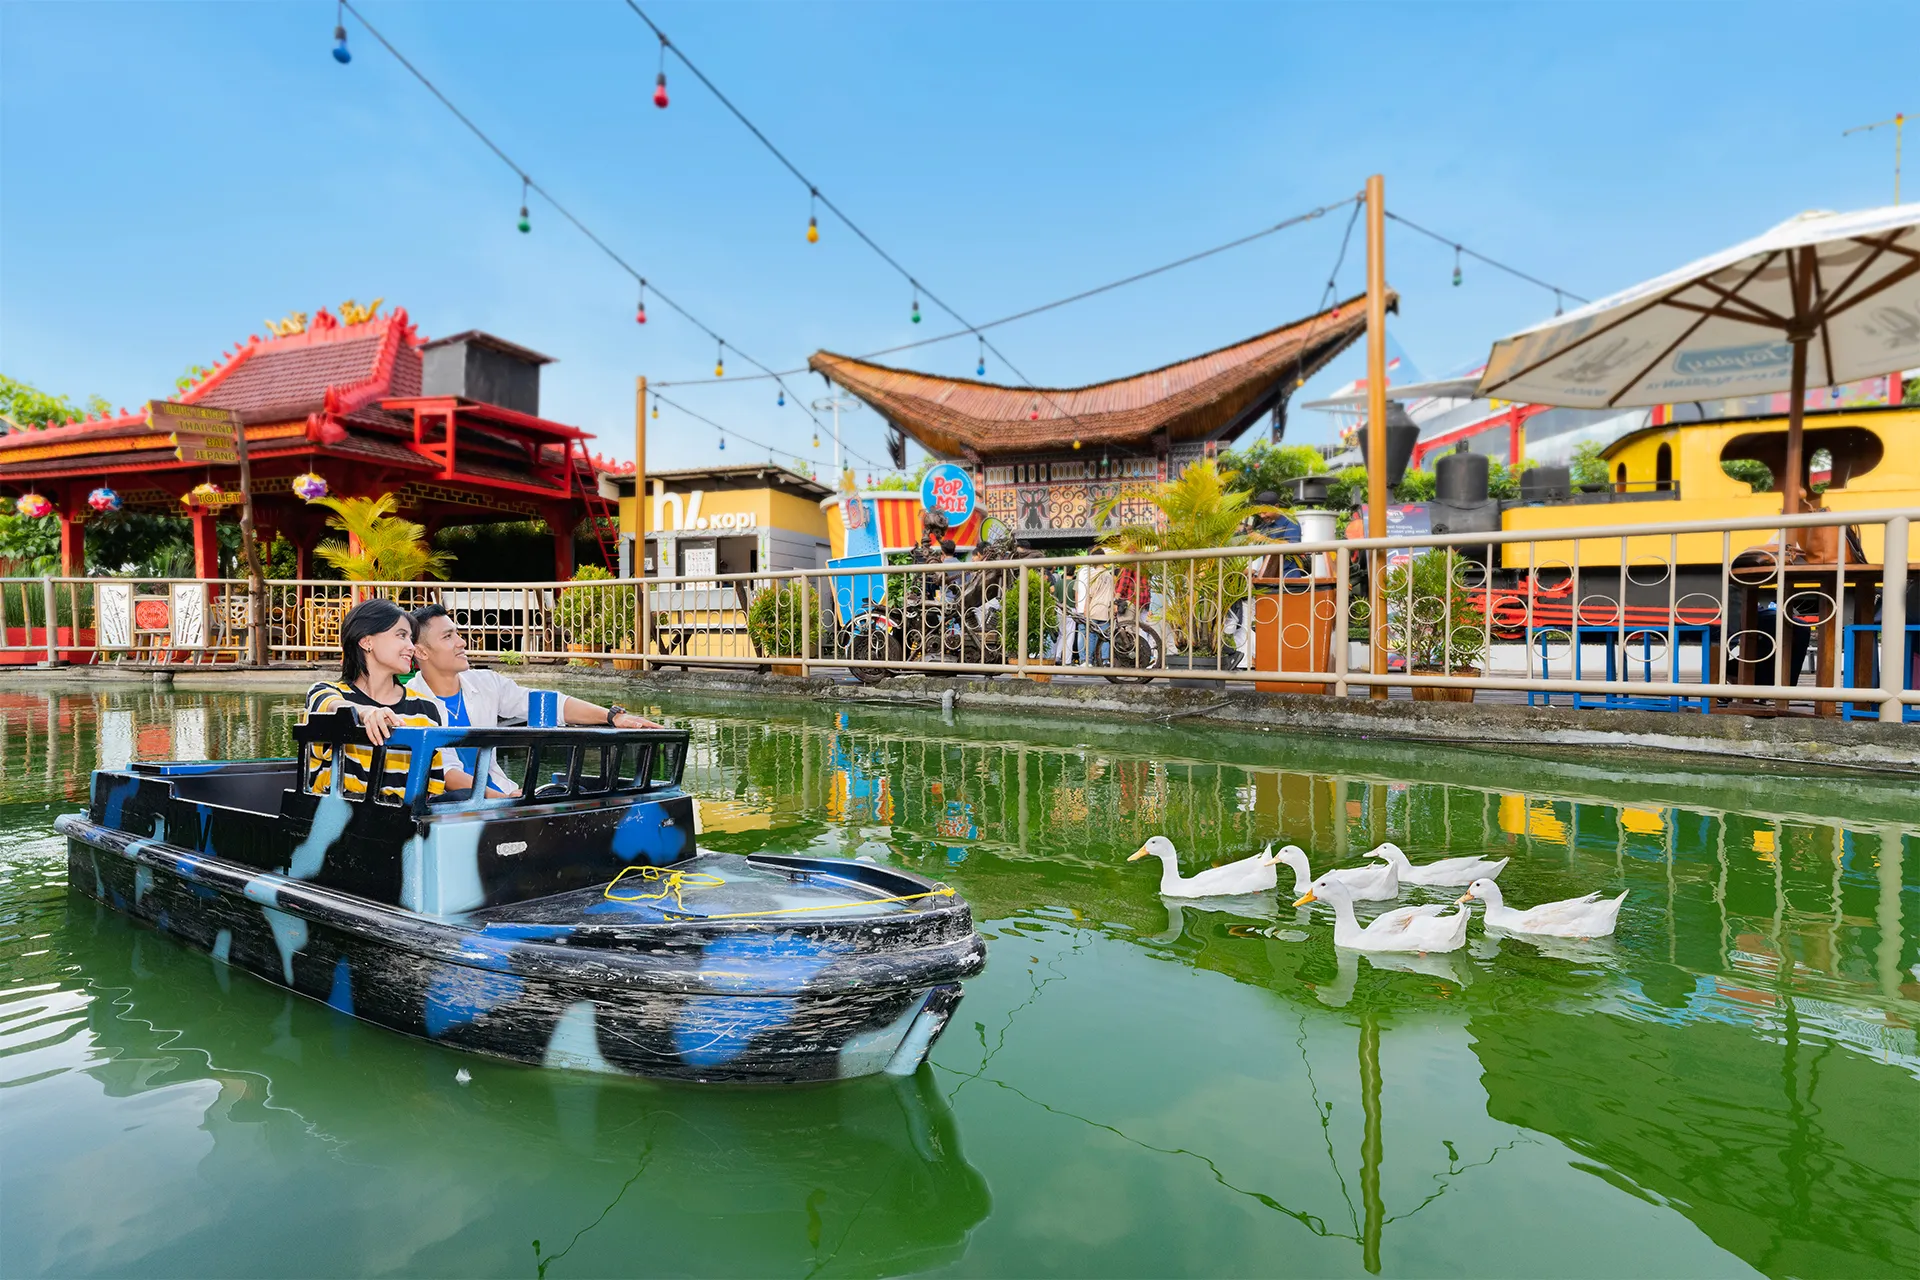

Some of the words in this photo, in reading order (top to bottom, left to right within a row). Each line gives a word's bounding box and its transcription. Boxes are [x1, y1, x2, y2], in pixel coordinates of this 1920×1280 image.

[179, 420, 233, 434] THAILAND
[206, 438, 230, 448] BALI
[195, 450, 236, 461] JEPANG
[932, 477, 962, 496] POP
[198, 493, 240, 503] TOILET
[936, 496, 967, 513] MIE
